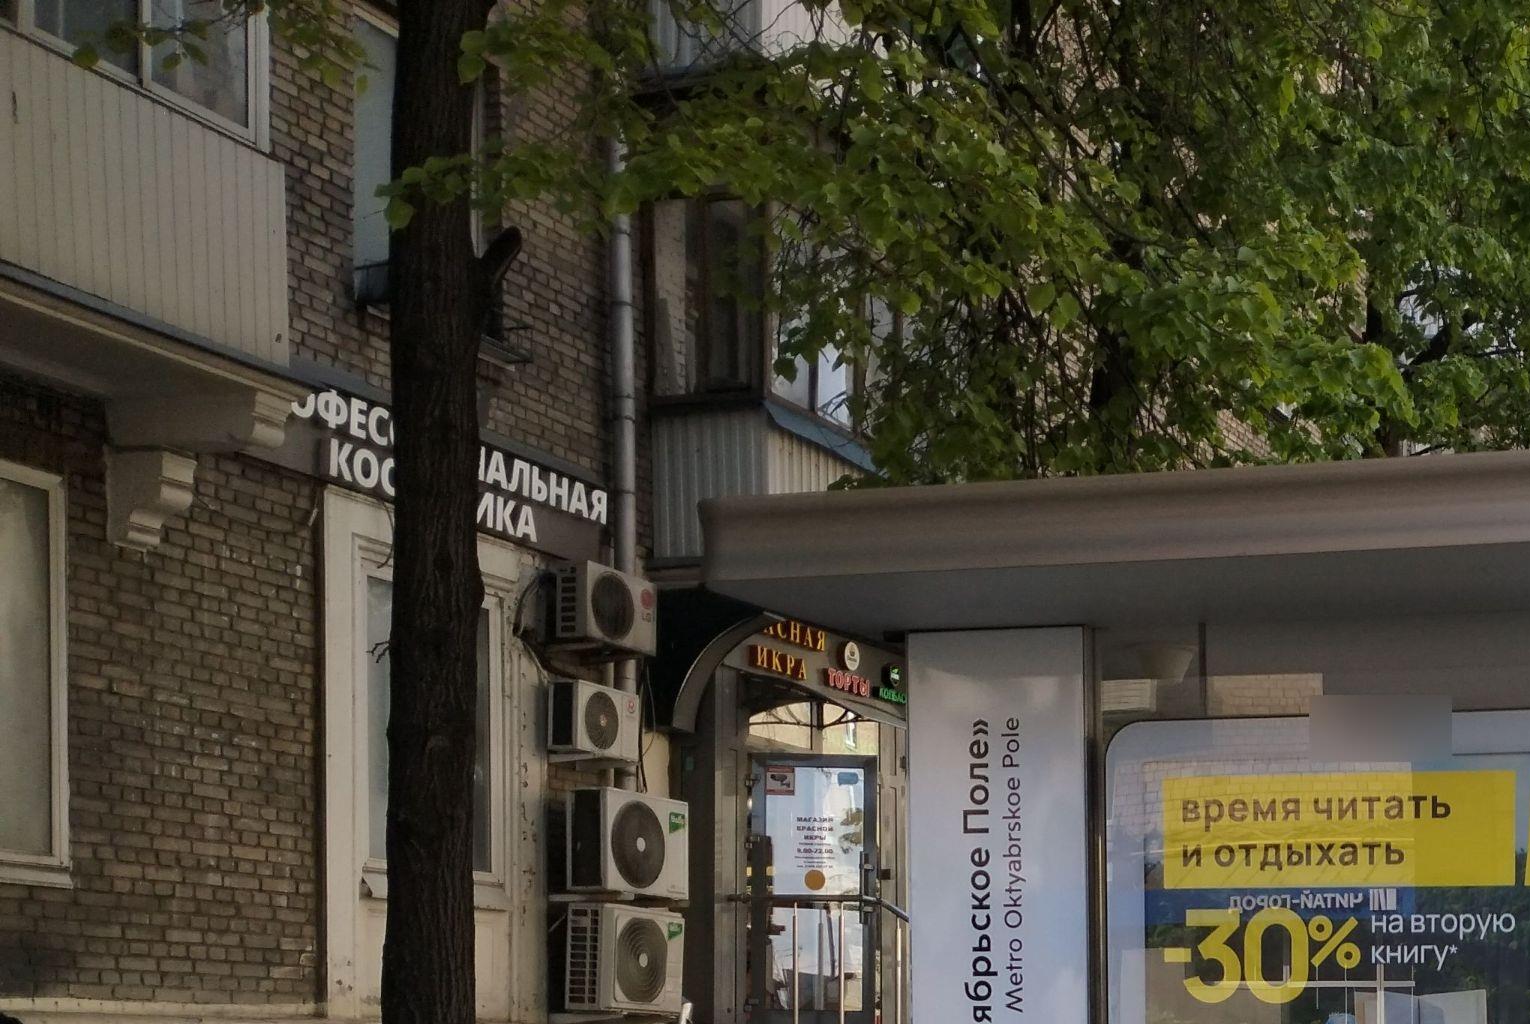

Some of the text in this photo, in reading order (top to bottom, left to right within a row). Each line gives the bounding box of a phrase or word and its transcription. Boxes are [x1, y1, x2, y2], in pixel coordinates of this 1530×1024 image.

[329, 437, 538, 543] КОСИКА
[763, 620, 826, 651] СНАЯ
[756, 644, 807, 681] ИКРА
[828, 667, 870, 698] ТОРТЫ
[879, 687, 907, 704] КОЛБАС
[962, 718, 990, 834] Поле»
[1182, 795, 1451, 832] время читать
[1001, 716, 1027, 1013] Metro Oktyabrskoe Pole
[1182, 841, 1405, 871] и отдыхать
[1371, 911, 1516, 940] на вторую
[1164, 908, 1361, 1004] -30%
